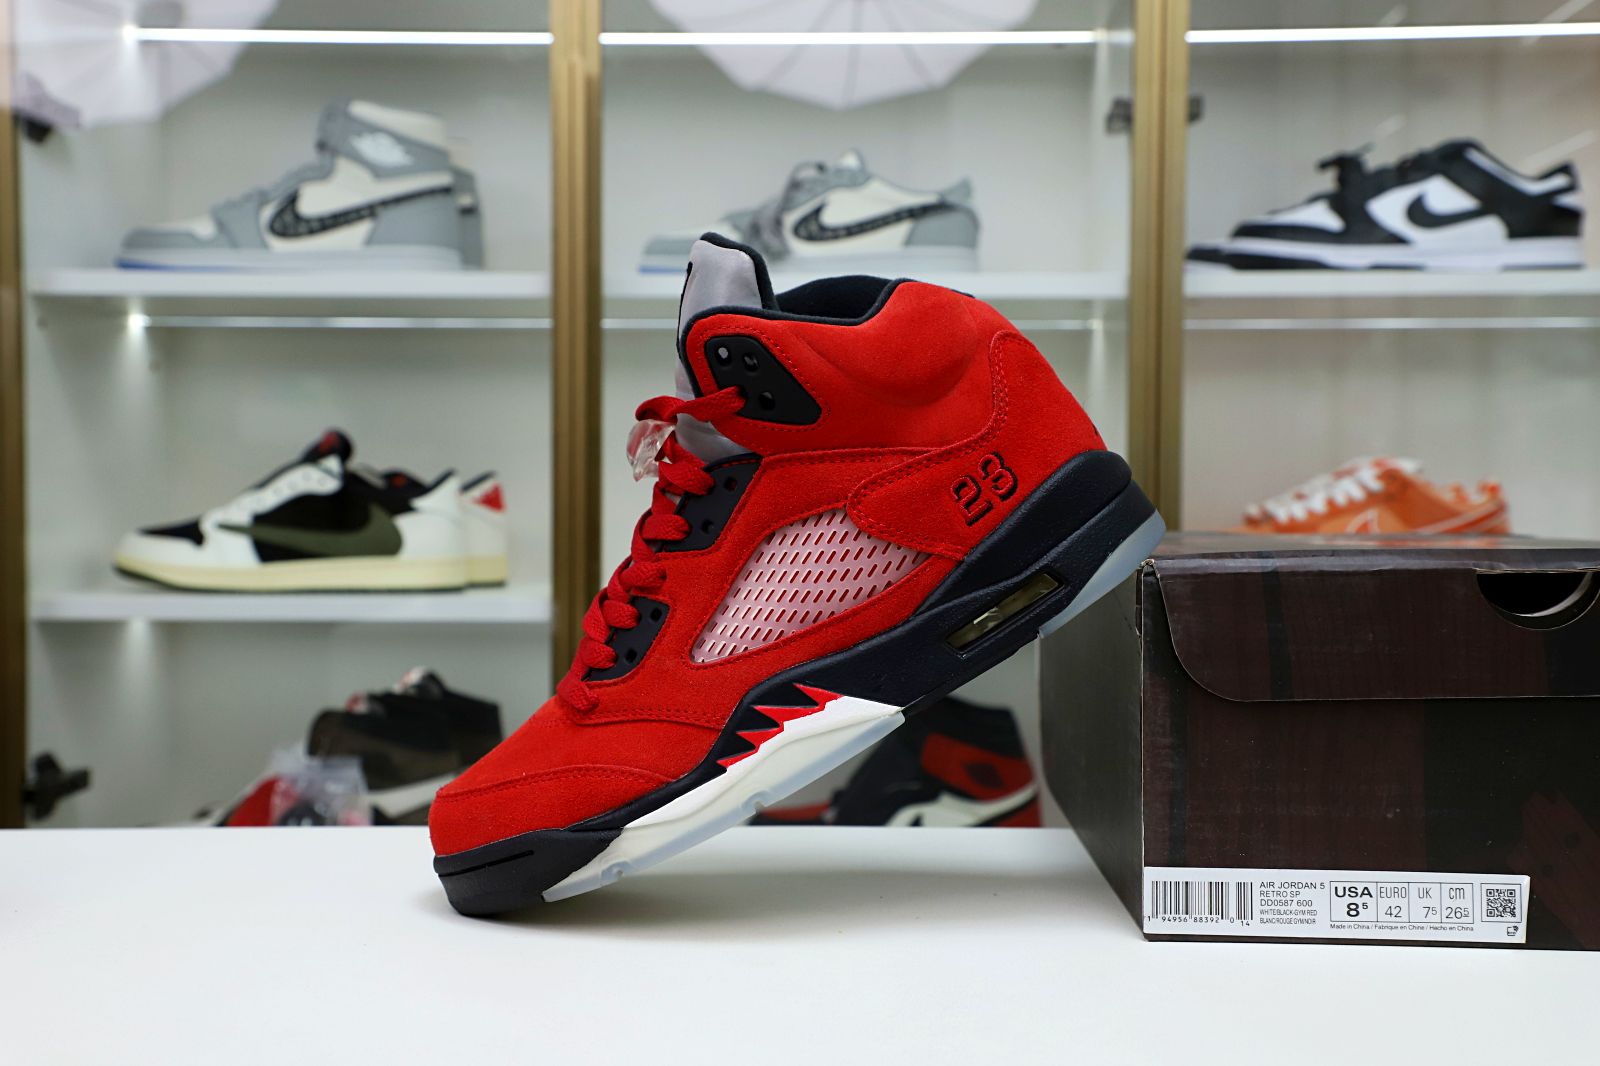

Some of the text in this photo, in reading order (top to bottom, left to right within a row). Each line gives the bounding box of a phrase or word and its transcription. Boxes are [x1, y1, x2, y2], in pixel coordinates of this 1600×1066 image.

[951, 451, 1018, 526] 23
[1260, 881, 1275, 889] AIR
[1278, 881, 1317, 890] JORDAN
[1260, 890, 1300, 898] RETRO SP
[1334, 886, 1373, 899] USA
[1380, 886, 1407, 899] EURO
[1418, 887, 1432, 899] UK
[1260, 899, 1313, 907] DD0587 600
[1385, 905, 1402, 918] 42
[1374, 923, 1399, 931] Fabrique
